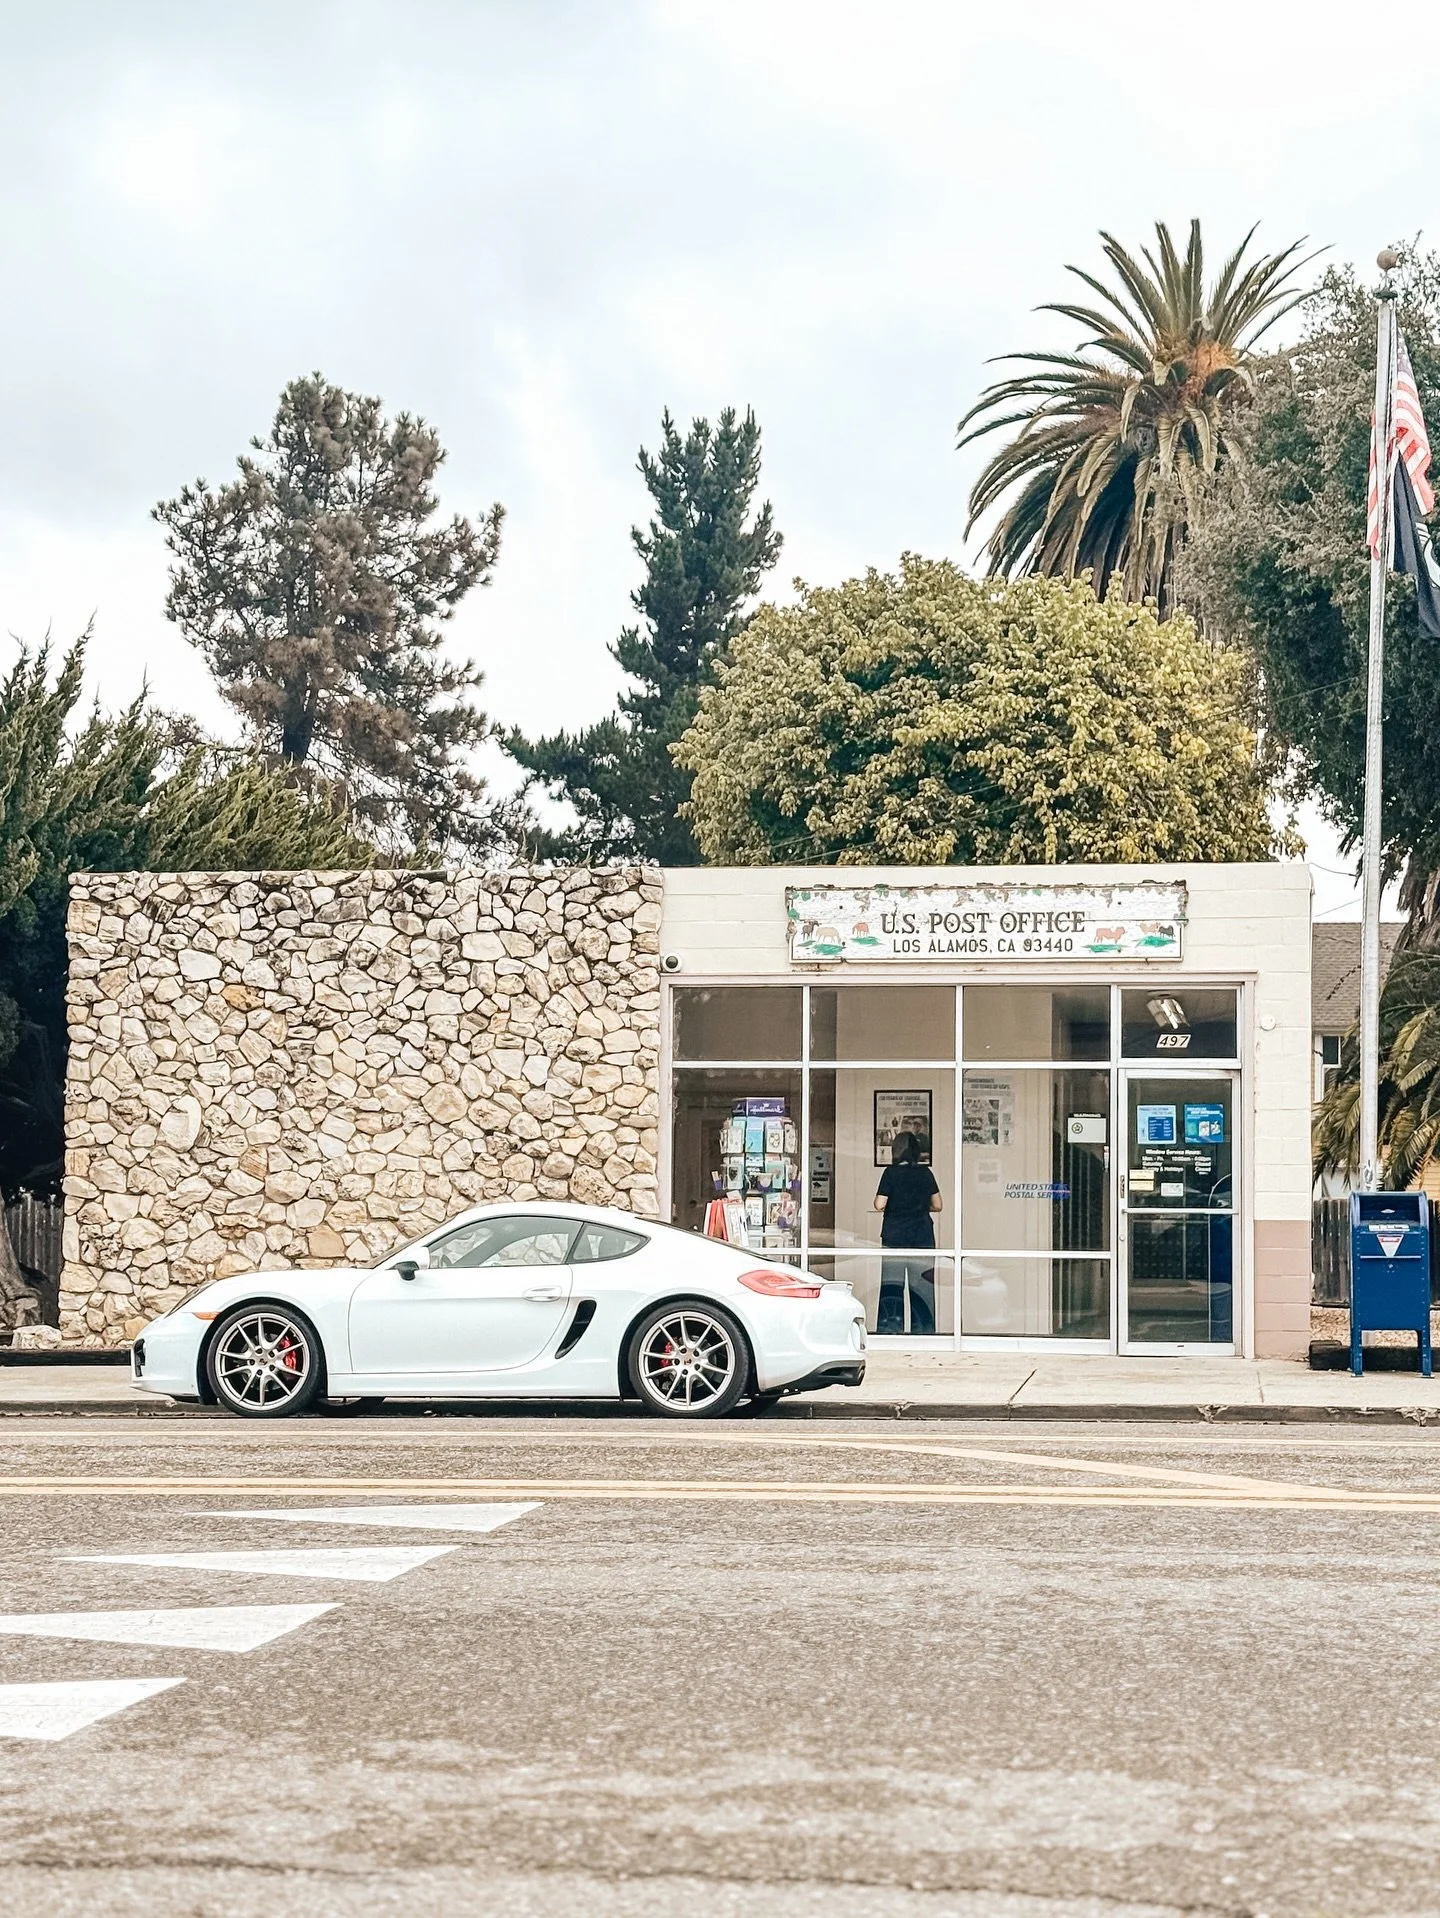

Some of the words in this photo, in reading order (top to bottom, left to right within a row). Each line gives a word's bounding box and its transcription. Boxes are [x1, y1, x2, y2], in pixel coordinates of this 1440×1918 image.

[881, 913, 920, 934] U.S.
[929, 913, 990, 933] POST
[1000, 911, 1085, 933] OFFICE
[893, 938, 921, 953] LOS
[928, 938, 993, 953] ALAMOS,
[998, 938, 1016, 953] CA
[1159, 1036, 1188, 1046] 497
[1006, 1183, 1038, 1191] UNITED
[1004, 1191, 1035, 1199] POSTAL
